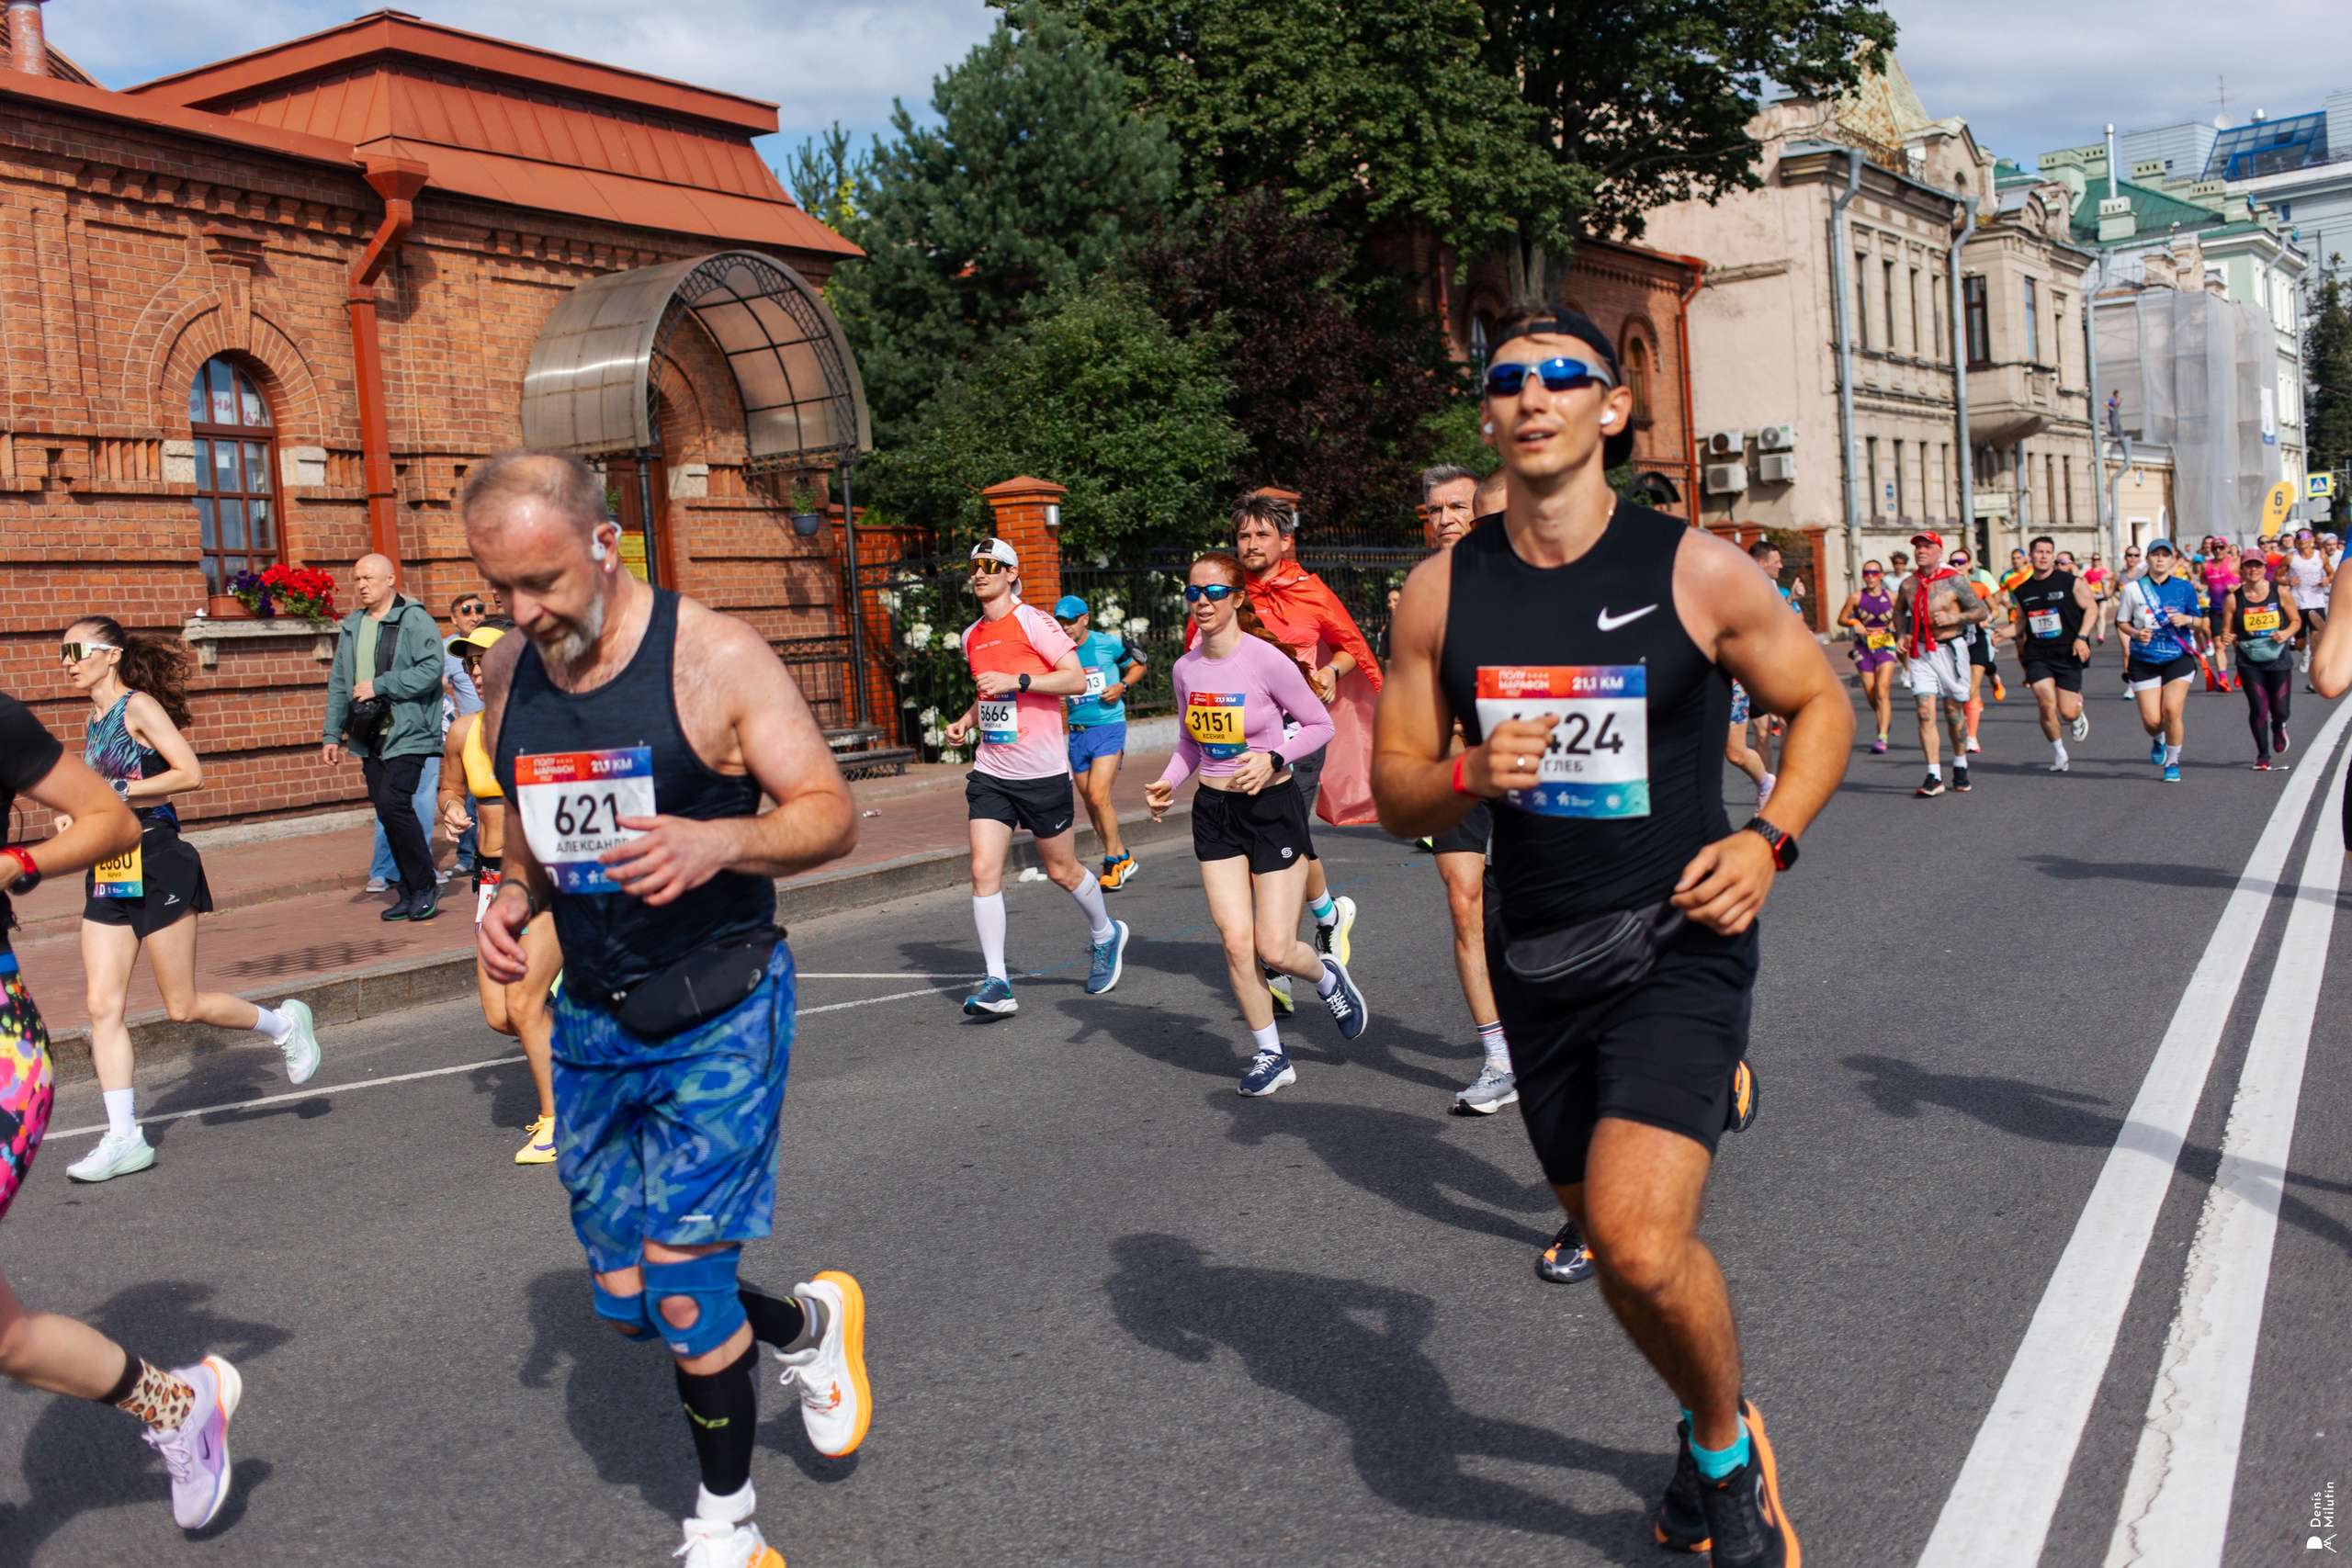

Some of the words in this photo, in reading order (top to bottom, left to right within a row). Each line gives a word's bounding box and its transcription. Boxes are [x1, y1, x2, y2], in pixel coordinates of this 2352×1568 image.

[2275, 491, 2283, 506] 6
[2038, 618, 2053, 626] 175
[2249, 615, 2275, 626] 2623
[981, 705, 1009, 722] 5666
[1192, 711, 1232, 732] 3151
[1544, 761, 1583, 772] ГЛЕБ
[555, 793, 621, 836] 621
